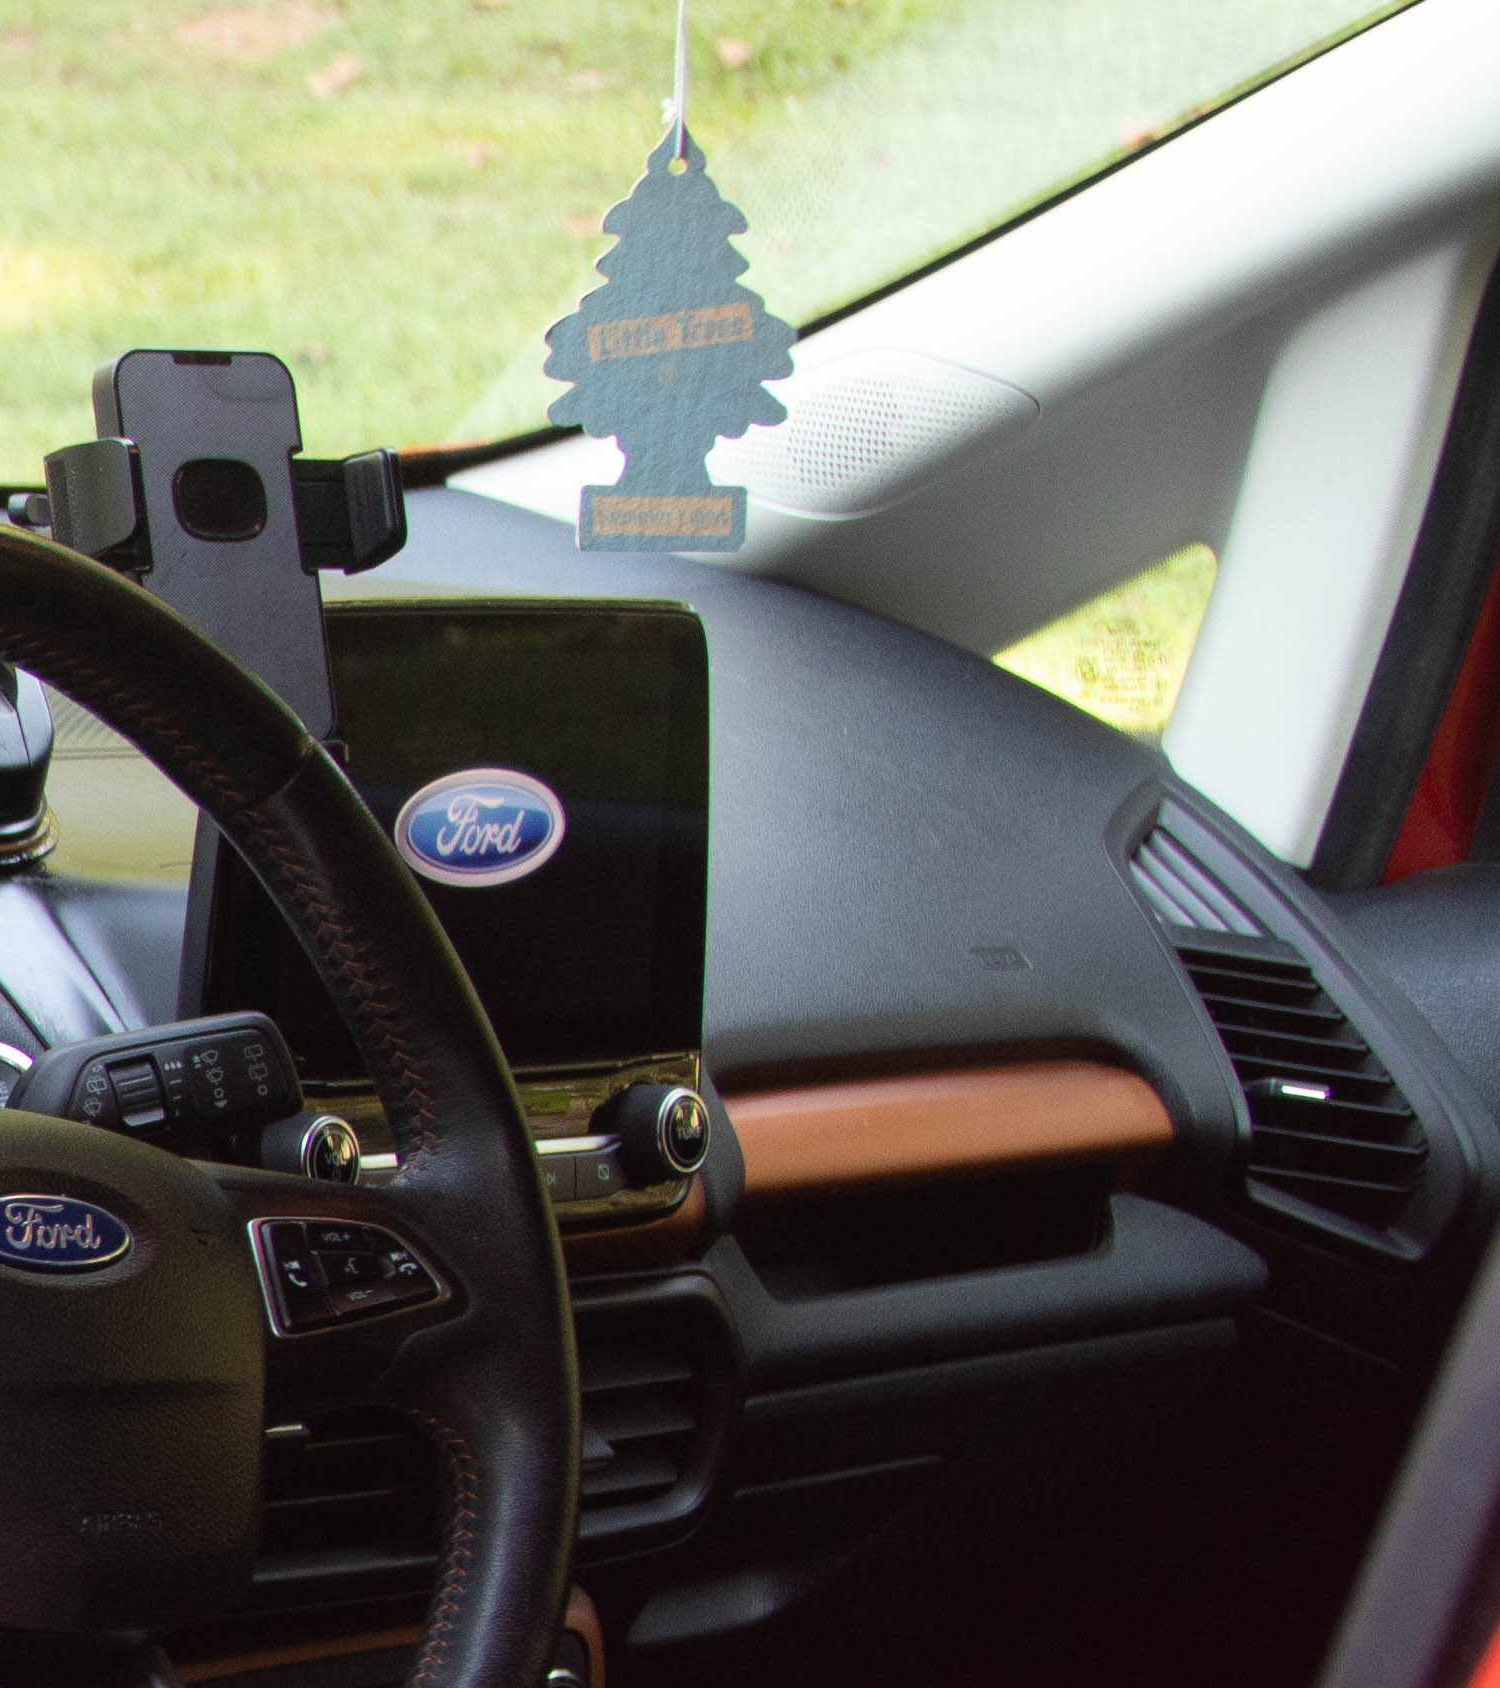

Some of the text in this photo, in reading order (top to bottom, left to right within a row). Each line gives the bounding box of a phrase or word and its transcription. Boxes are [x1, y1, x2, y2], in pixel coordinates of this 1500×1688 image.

[436, 794, 526, 857] Ford
[323, 1151, 349, 1167] VOL
[5, 1202, 102, 1250] Ford
